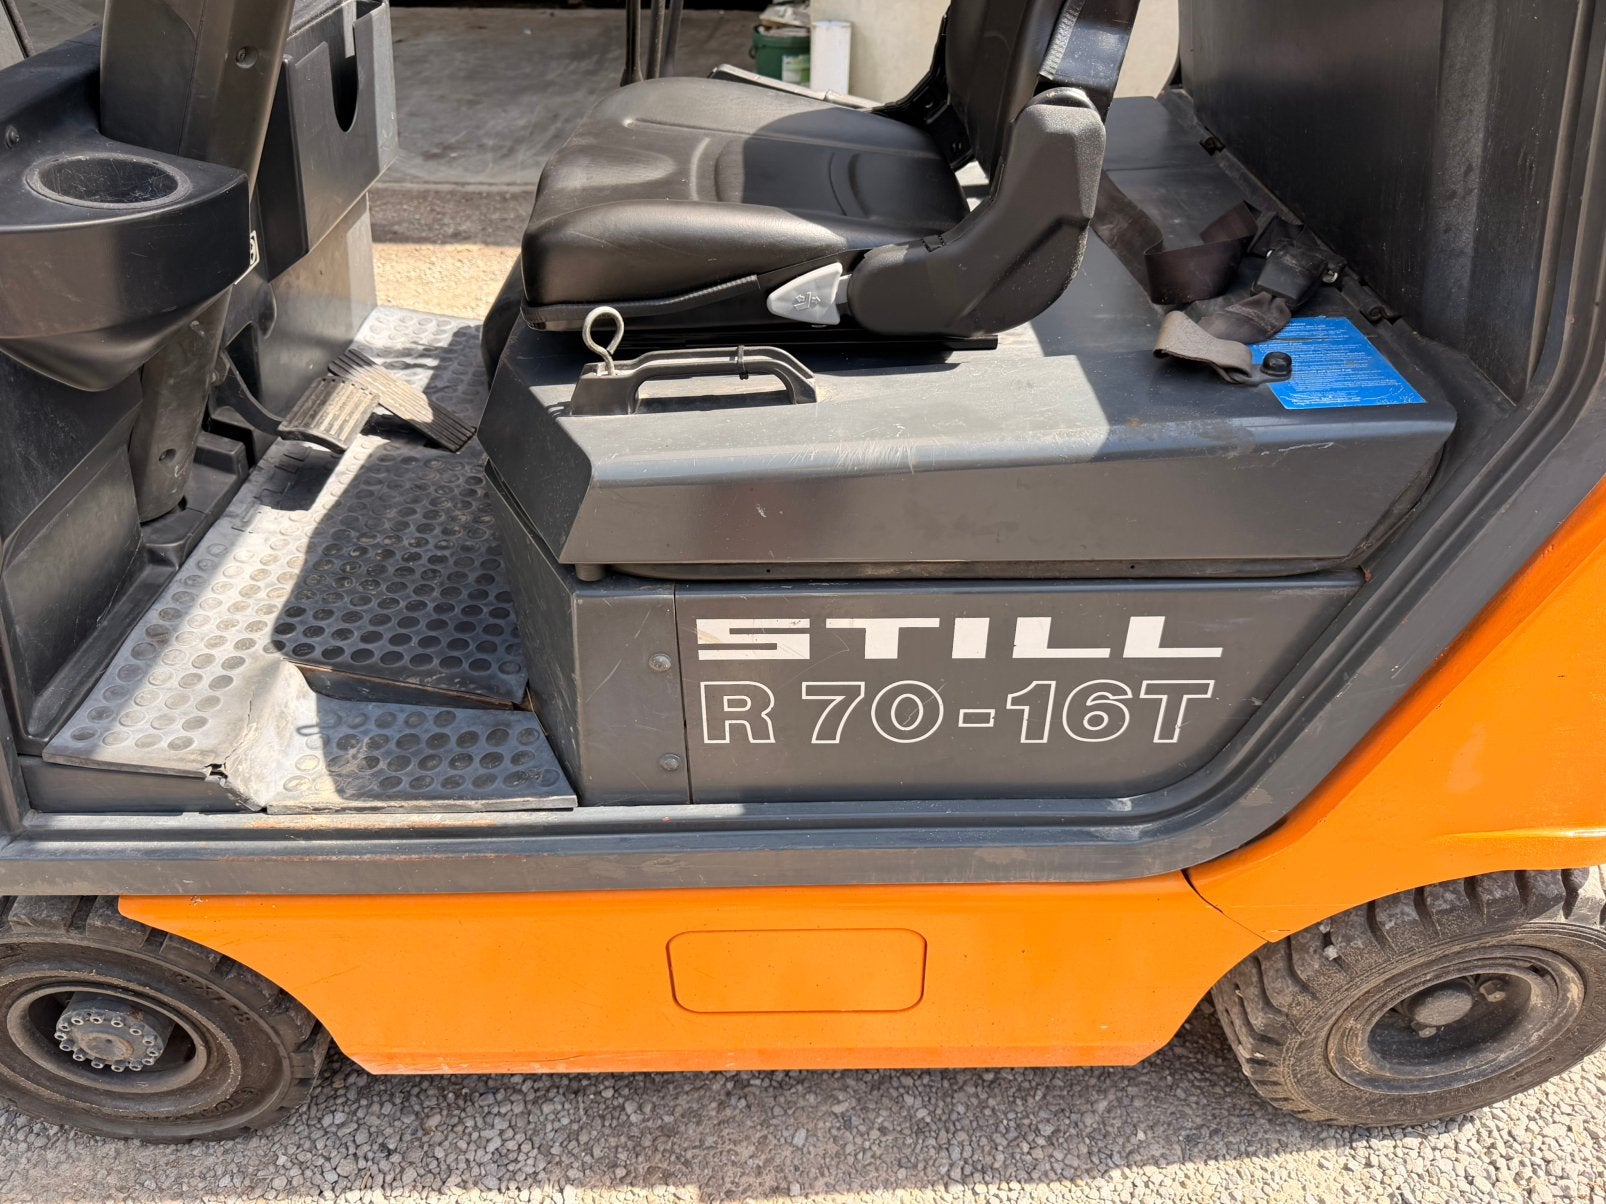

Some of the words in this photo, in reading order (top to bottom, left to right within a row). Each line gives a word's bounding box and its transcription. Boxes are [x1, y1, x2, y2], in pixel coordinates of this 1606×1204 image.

[696, 616, 1223, 660] STILL
[700, 681, 776, 744] R
[801, 679, 1216, 744] 70-16T
